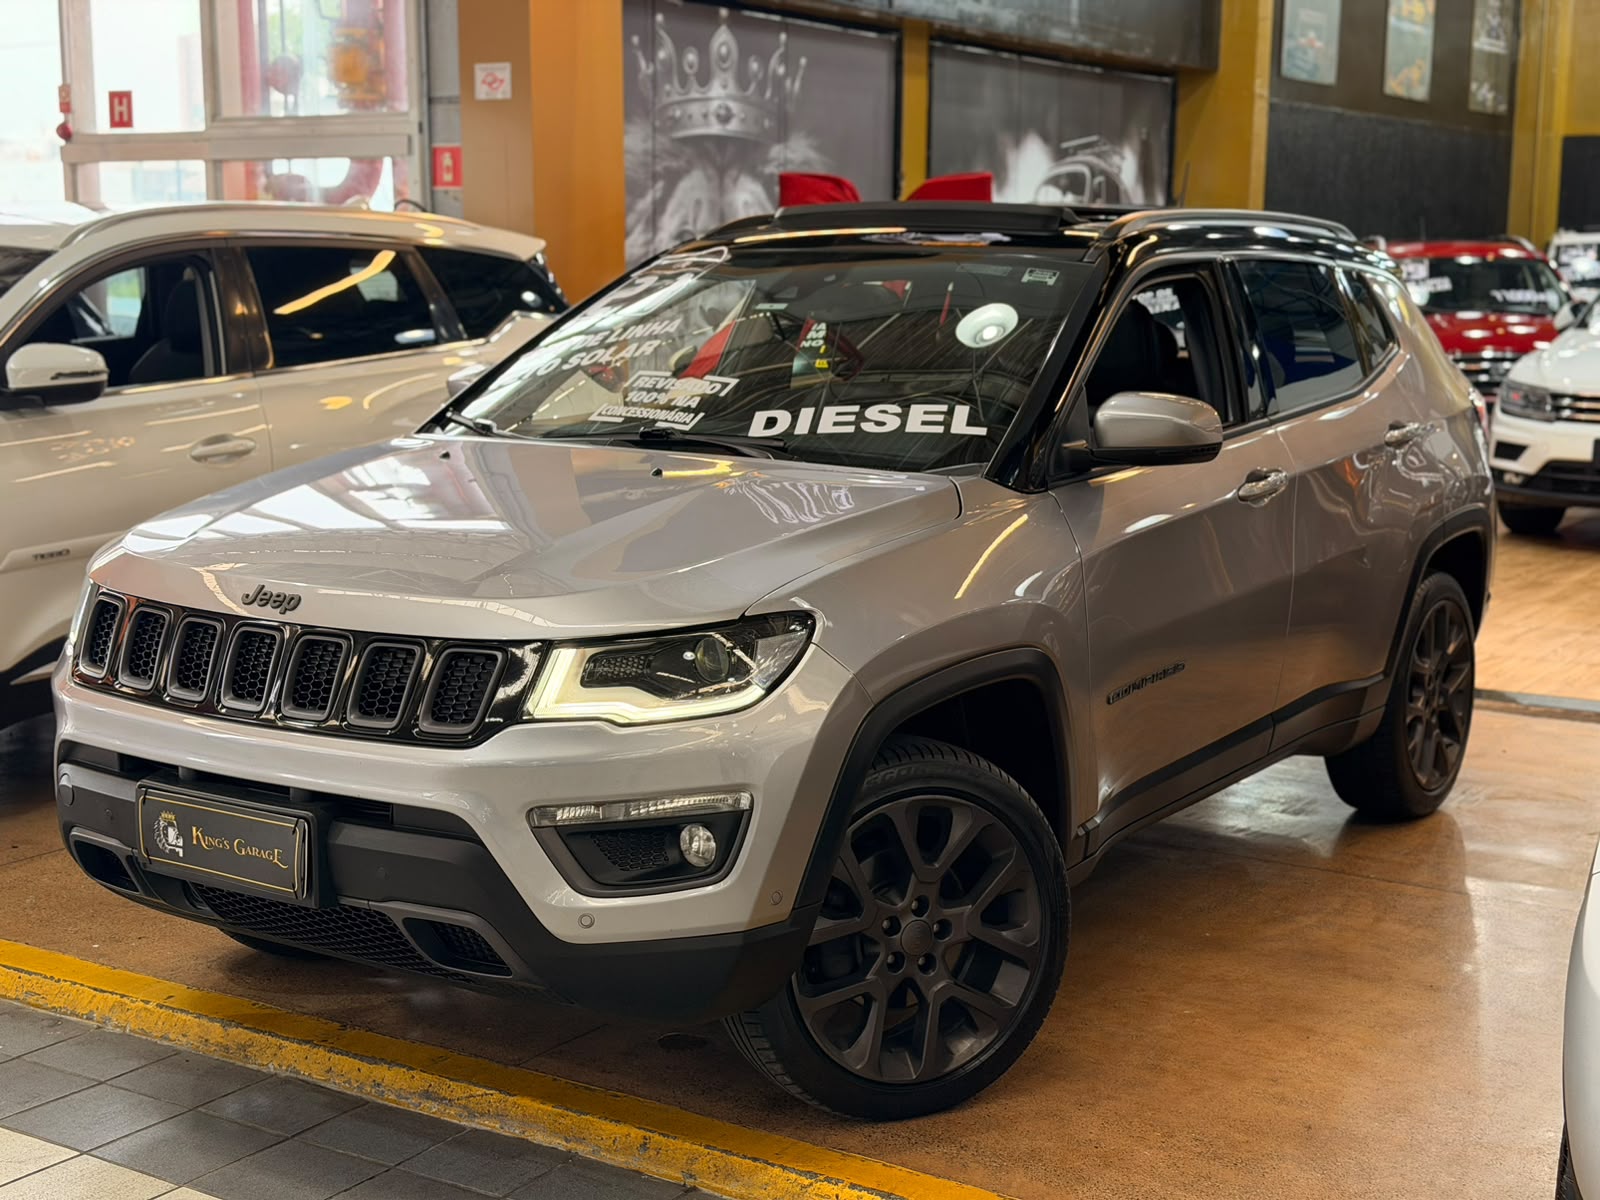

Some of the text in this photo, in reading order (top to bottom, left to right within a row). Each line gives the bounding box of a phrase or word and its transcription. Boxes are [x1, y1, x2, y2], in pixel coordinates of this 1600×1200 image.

[113, 97, 129, 123] H
[606, 318, 683, 343] LINHA
[561, 339, 662, 370] SOLAR
[632, 376, 722, 394] REVISADO
[625, 391, 702, 409] 100% NA
[601, 405, 696, 424] CONCESSIONÁRIA
[748, 404, 988, 437] DIESEL
[241, 584, 301, 615] Jeep
